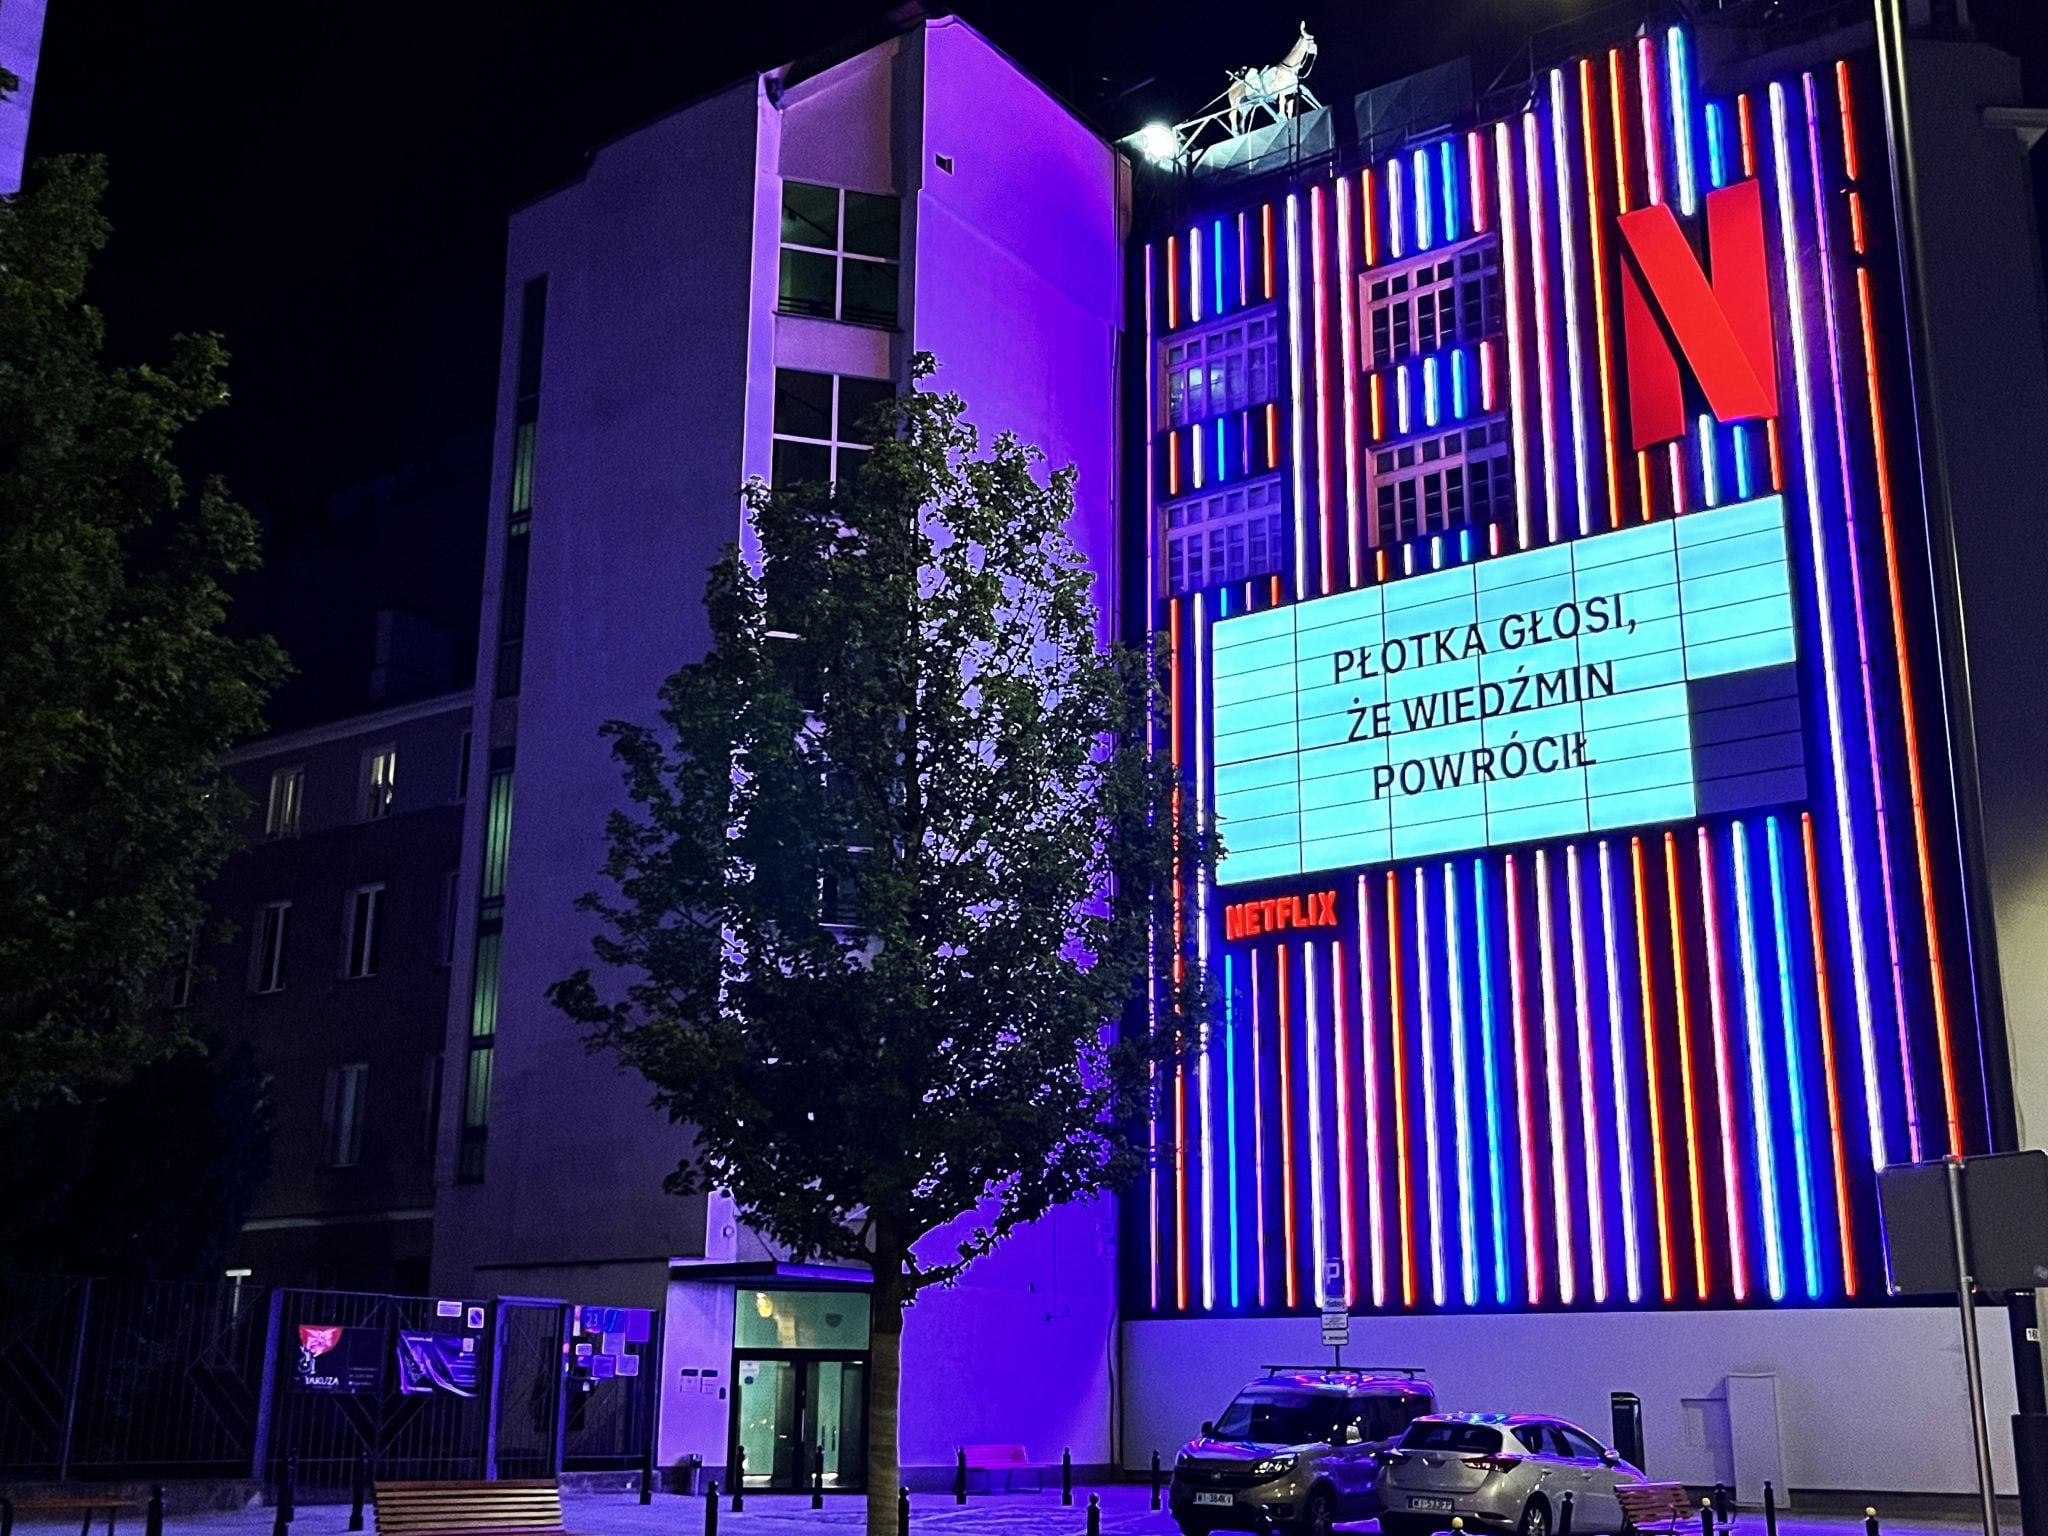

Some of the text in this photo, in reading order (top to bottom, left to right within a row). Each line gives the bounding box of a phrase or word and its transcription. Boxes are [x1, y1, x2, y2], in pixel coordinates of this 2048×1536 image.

[1616, 178, 1778, 451] N
[1333, 592, 1637, 684] PŁOTKA GŁOSI,
[1346, 659, 1615, 743] ŻE WIEDŹMIN
[1372, 730, 1597, 801] POWRÓCIŁ
[1225, 890, 1337, 941] NETFLIX
[1326, 1262, 1340, 1285] P
[305, 1376, 340, 1386] YAKUZA
